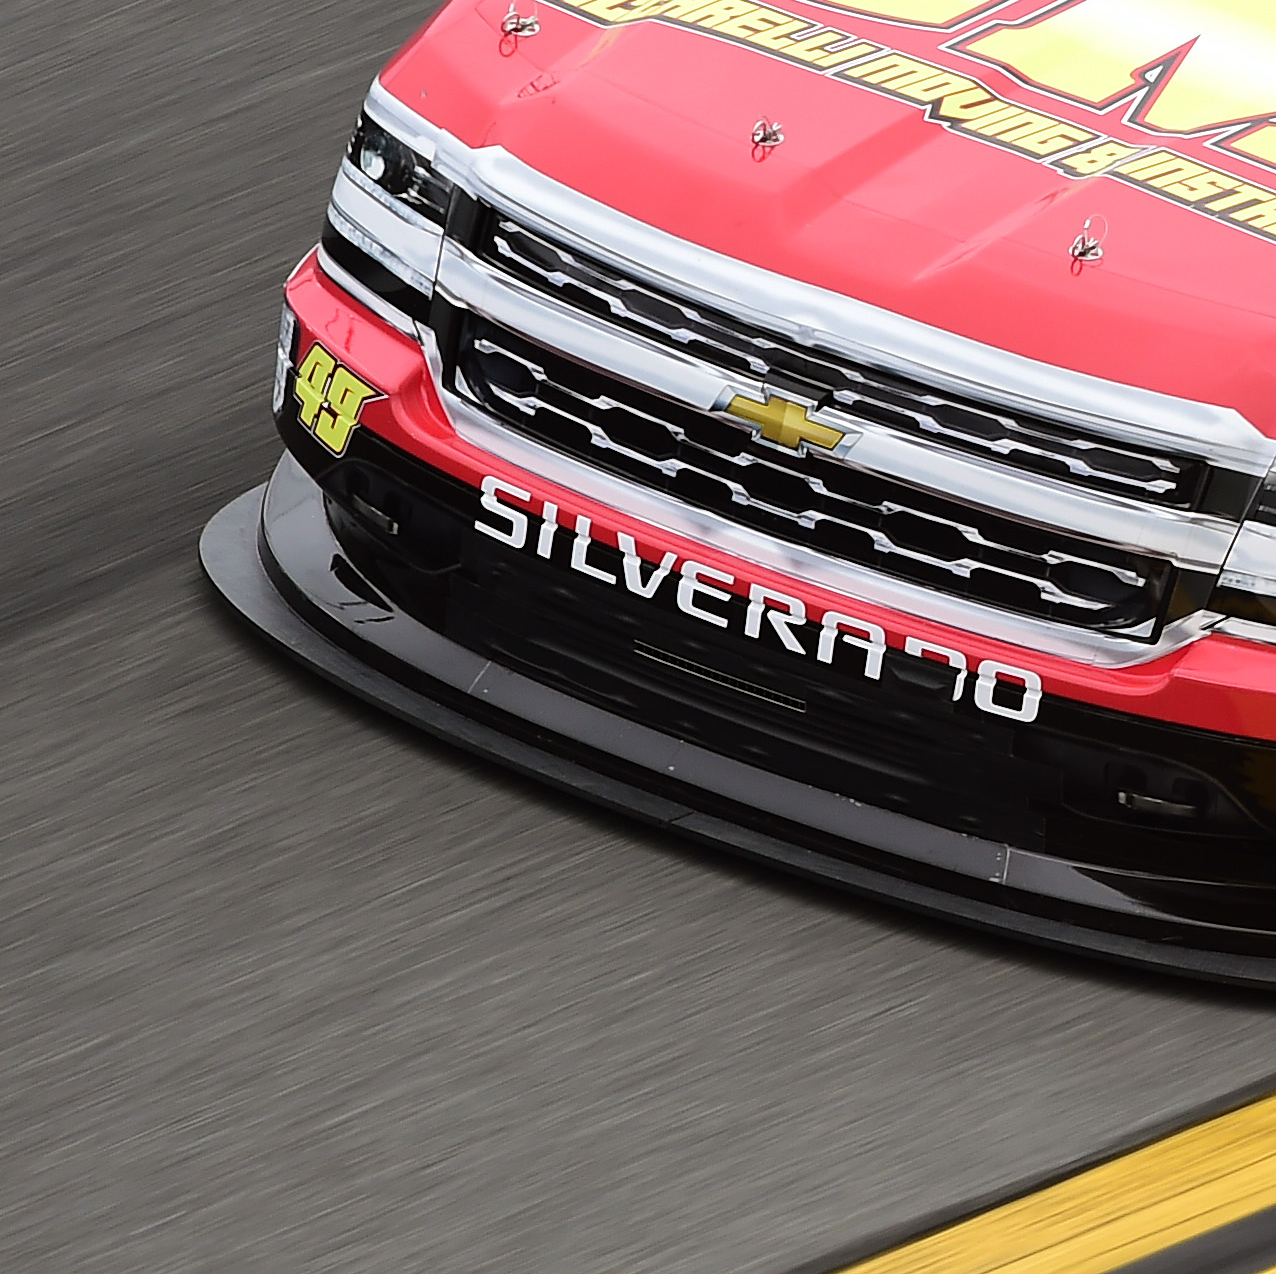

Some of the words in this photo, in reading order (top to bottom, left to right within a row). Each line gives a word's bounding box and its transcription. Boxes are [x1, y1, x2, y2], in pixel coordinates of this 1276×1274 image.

[840, 49, 1102, 163] MOVING
[1060, 139, 1142, 178] &
[293, 341, 384, 456] 49
